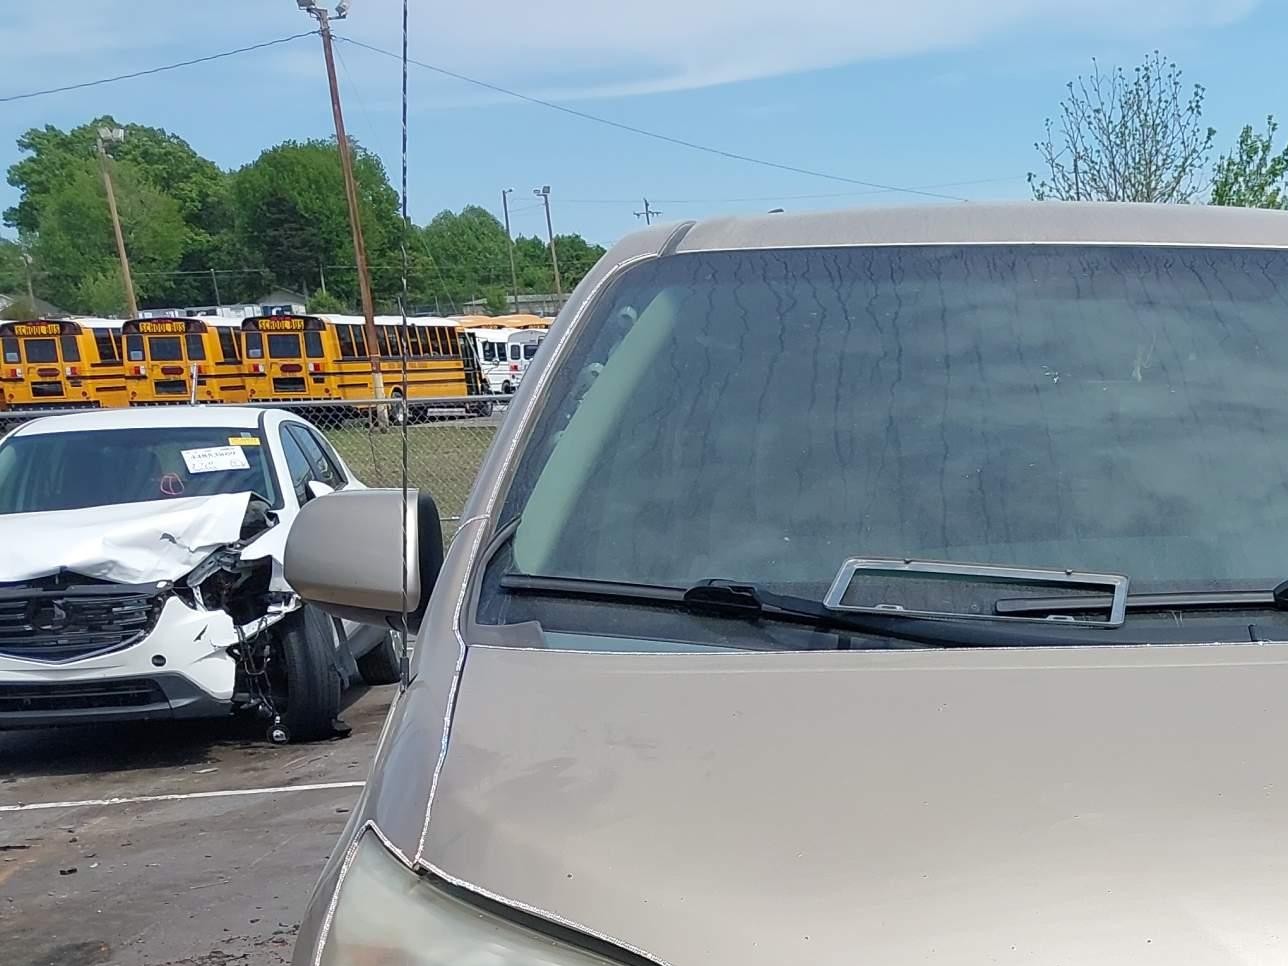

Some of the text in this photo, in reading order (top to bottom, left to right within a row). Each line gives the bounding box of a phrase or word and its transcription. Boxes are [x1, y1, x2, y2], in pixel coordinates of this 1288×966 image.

[15, 324, 60, 336] SCHOOL BUS
[140, 322, 186, 333] SCHOOL BUS
[259, 319, 304, 330] SCHOOL BUS
